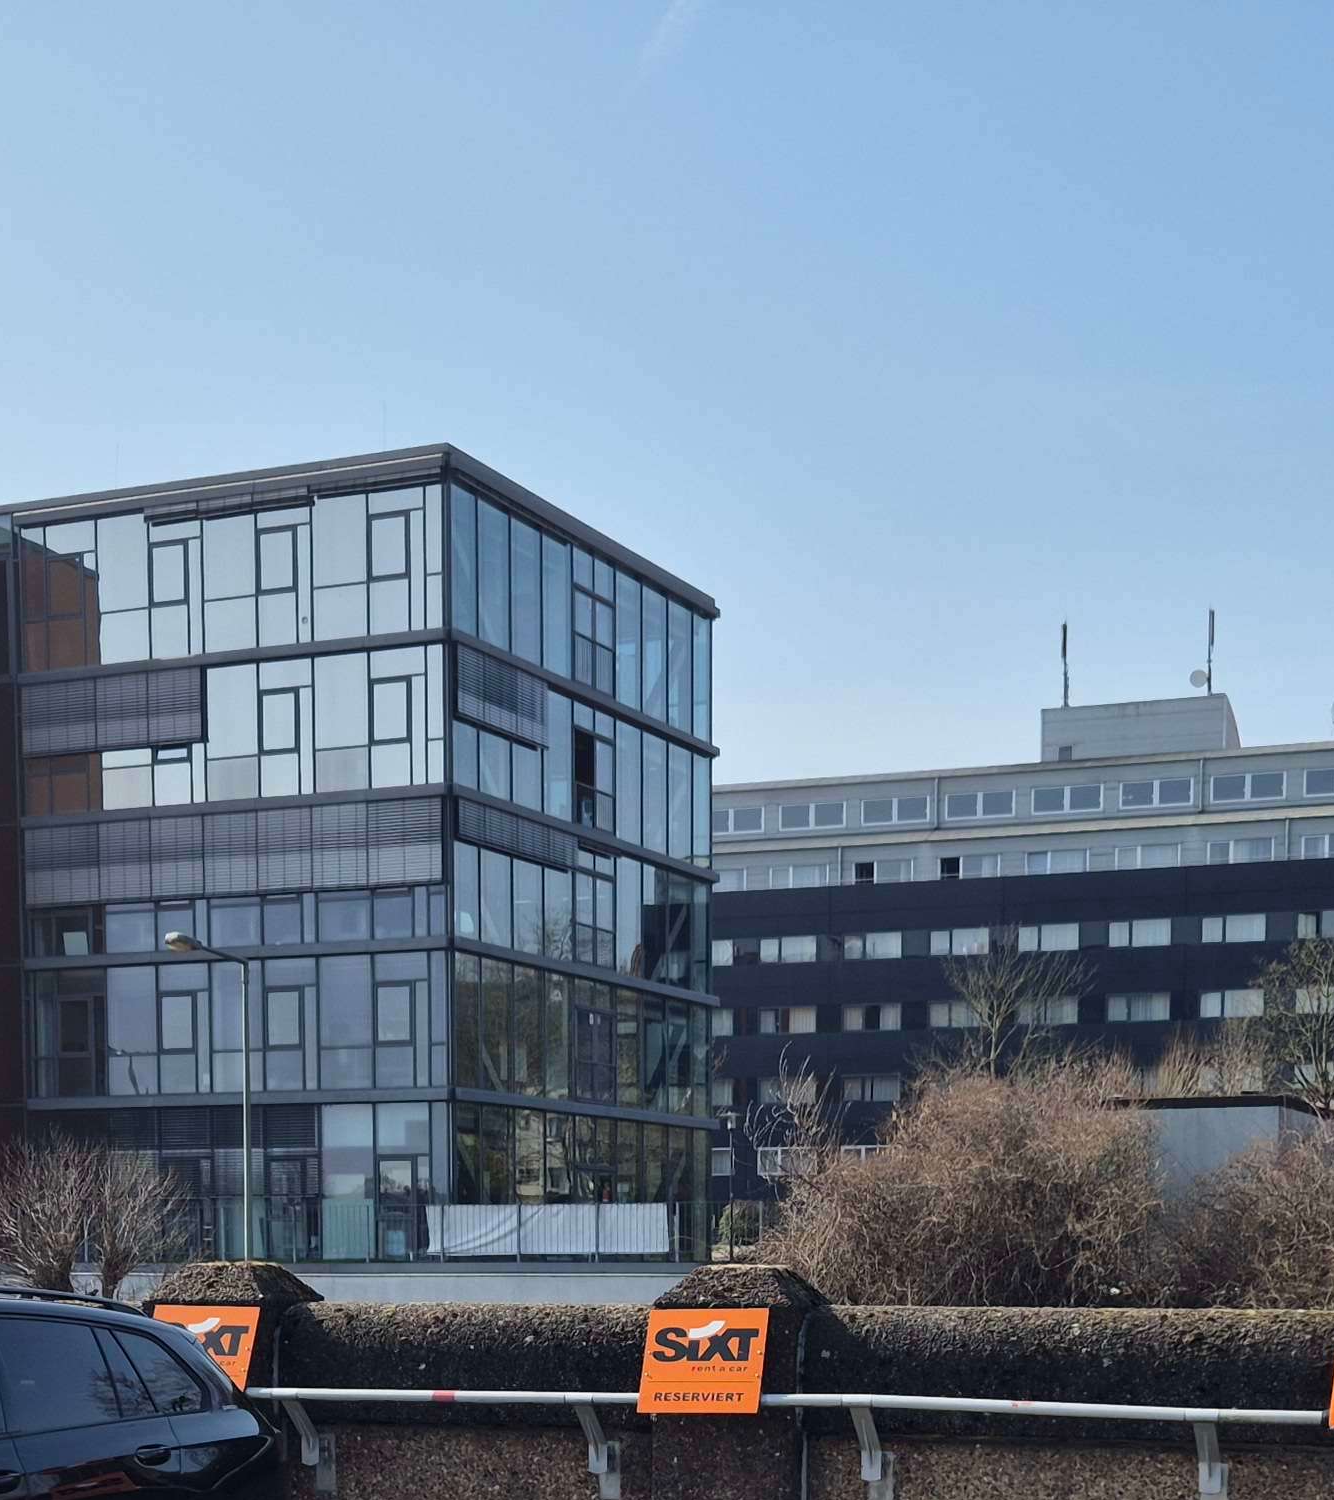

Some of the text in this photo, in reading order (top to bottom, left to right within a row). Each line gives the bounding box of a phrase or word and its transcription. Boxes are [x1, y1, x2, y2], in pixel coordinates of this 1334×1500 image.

[691, 1365, 748, 1373] rent a car
[653, 1392, 745, 1402] RESERVIERT
